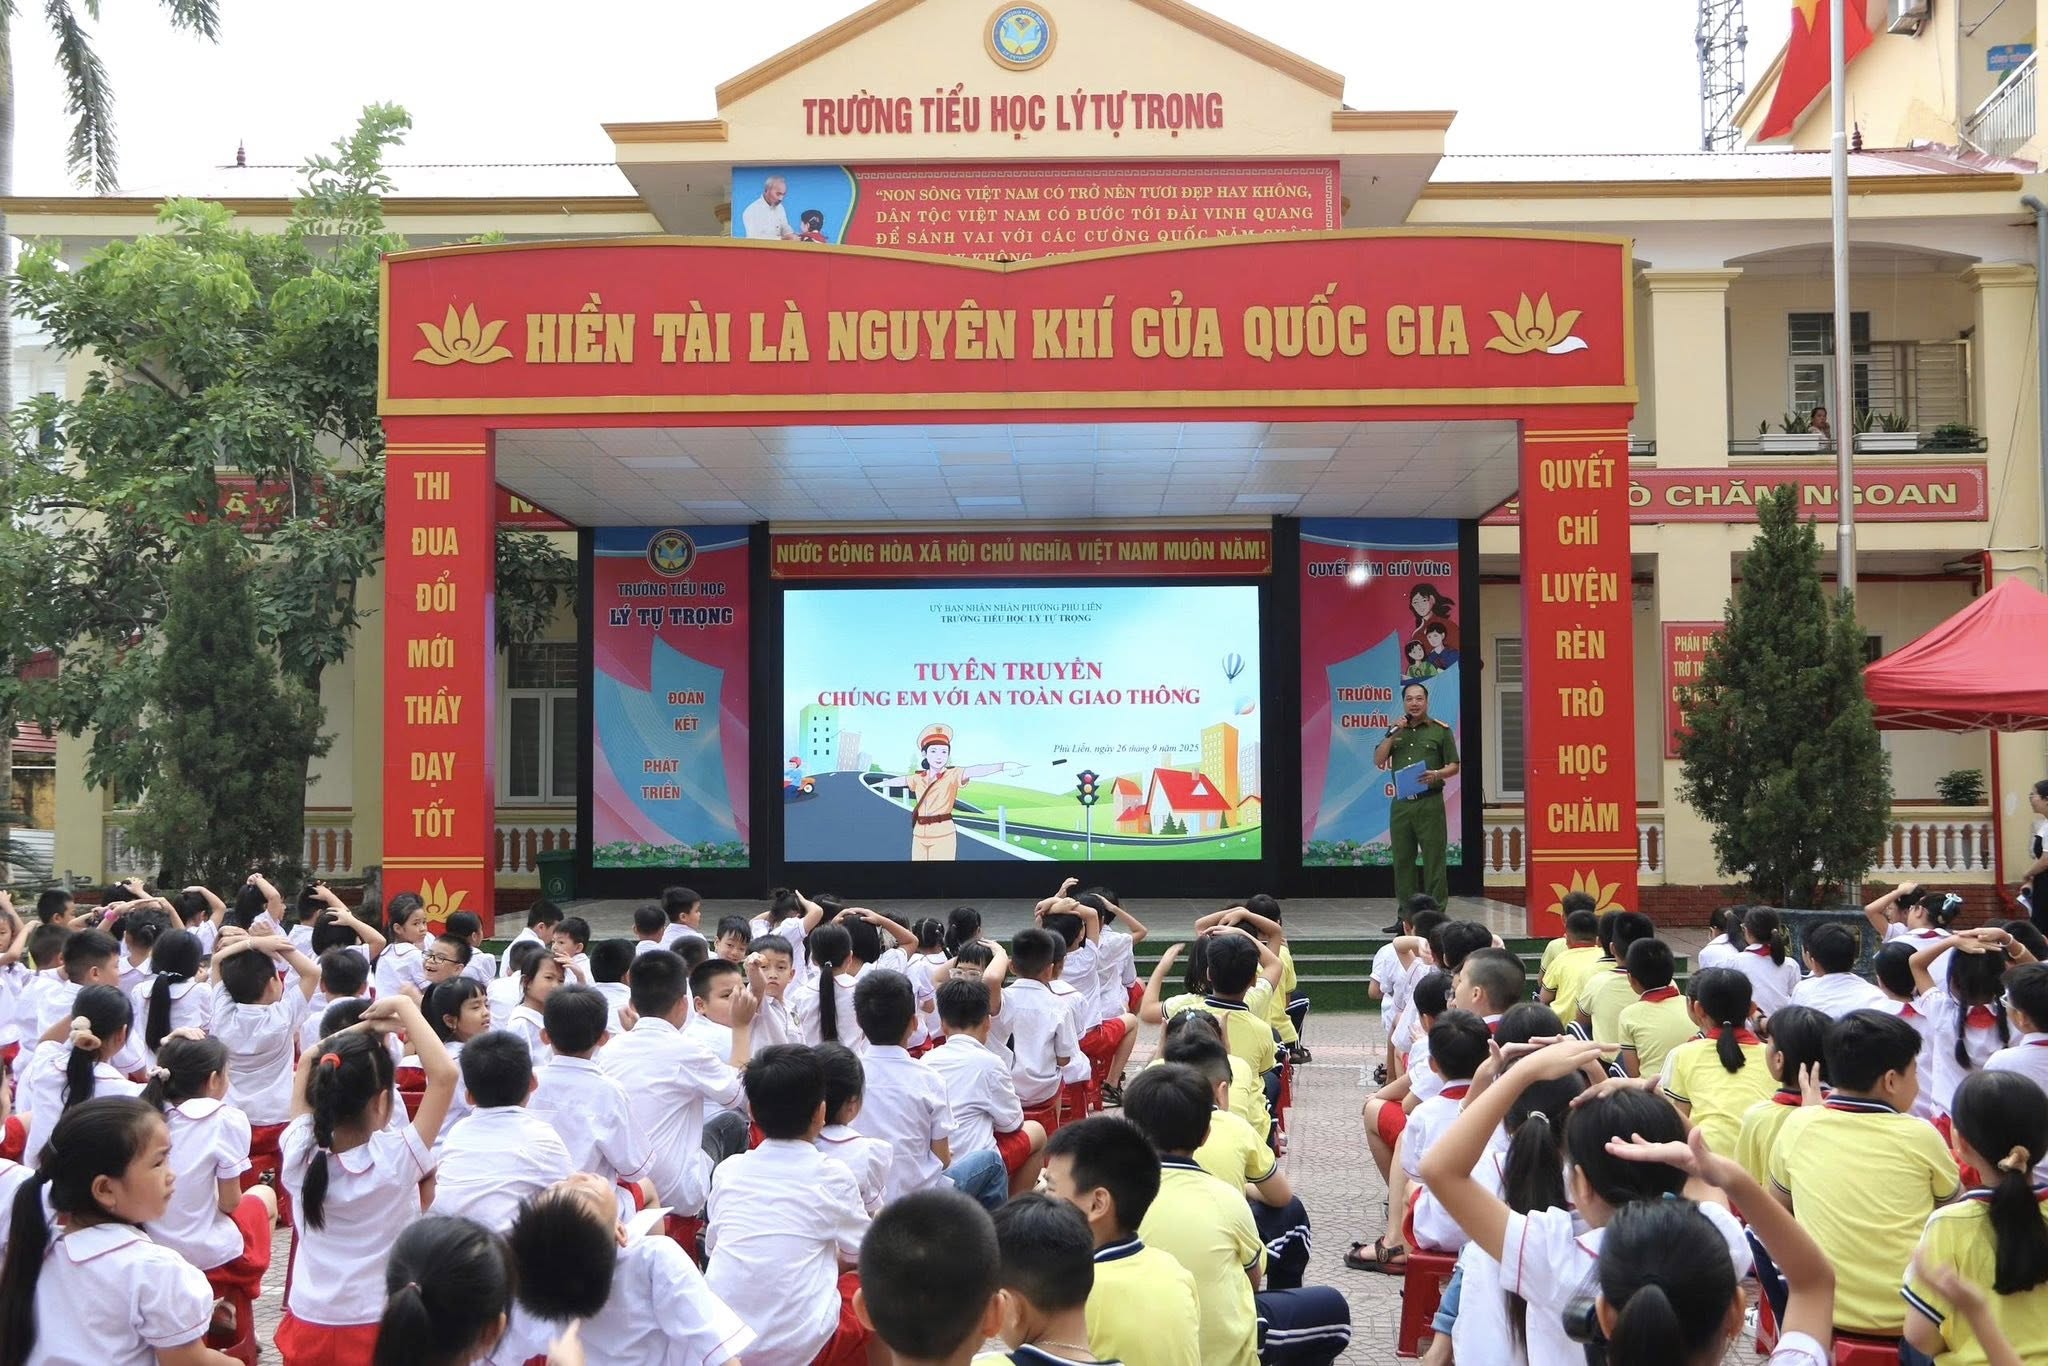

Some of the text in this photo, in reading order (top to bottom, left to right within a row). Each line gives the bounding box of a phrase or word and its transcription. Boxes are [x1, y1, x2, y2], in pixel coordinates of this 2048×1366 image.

[802, 89, 913, 135] TRƯỜNG
[991, 95, 1046, 140] HỌC
[1056, 88, 1087, 131] LÝ
[1090, 90, 1128, 138] TỰ
[1131, 92, 1223, 138] TRỌNG
[919, 186, 961, 201] SÔNG
[965, 185, 1001, 203] VIỆT
[1005, 188, 1039, 200] NAM
[1043, 184, 1064, 200] CÓ
[1068, 183, 1099, 199] TRỞ
[1103, 184, 1136, 199] NÊN
[1140, 185, 1178, 199] TƯƠI
[1181, 186, 1213, 201] ĐẸP
[1217, 186, 1248, 198] HAY
[1252, 183, 1312, 200] KHÔNG,
[876, 205, 1313, 225] DÂN TỘC VIỆT NAM CÓ BƯỚC TỚI ĐÀI VINH QUANG
[876, 226, 900, 244] ĐỂ
[907, 229, 955, 244] SÁNH
[962, 231, 994, 243] VAI
[1001, 229, 1033, 243] VỚI
[1041, 229, 1076, 243] CÁC
[1157, 225, 1208, 241] QUỐC
[526, 282, 1470, 363] HIỀN TÀI LÀ NGUYÊN KHÍ CỦA QUỐC GIA
[1540, 449, 1615, 492] QUYẾT
[413, 472, 450, 500] THI
[1558, 509, 1599, 545] CHÍ
[412, 527, 459, 556] ĐUA
[776, 537, 1266, 567] NƯỚC CỘNG HÒA XÃ HỘI CHỦ NGHĨA VIỆT NAM MUÔN NĂM!
[1308, 558, 1452, 578] QUYẾT ÂM GIỮ VỮNG
[416, 569, 456, 612] ĐỔI
[618, 578, 725, 598] TRƯỜNG TIỂU HỌC
[1541, 566, 1618, 609] LUYỆN
[609, 604, 733, 631] LÝ TỰ TRỌNG
[940, 613, 981, 623] TRƯỜNG
[1006, 614, 1027, 624] HỌC
[1059, 614, 1092, 624] TRỌNG
[945, 604, 965, 612] BAN
[408, 632, 454, 668] MỚI
[1556, 623, 1605, 660] RÈN
[914, 656, 1103, 680] TUYÊN TRUYỀN
[404, 686, 462, 724] THẦY
[667, 688, 705, 705] ĐOÀN
[817, 684, 1200, 706] CHÚNG EM VỚI AN TOÀN GIAO THÔNG
[1336, 684, 1392, 701] TRƯỜNG
[1558, 680, 1605, 717] TRÒ
[674, 714, 699, 731] KẾT
[1116, 744, 1127, 753] 26
[1152, 743, 1158, 753] 9
[1179, 743, 1199, 752] 2025
[411, 752, 456, 788] DẠY
[643, 757, 679, 773] PHÁT
[1558, 744, 1607, 781] HỌC
[641, 780, 681, 800] TRIỂN
[412, 798, 455, 838] TỐT
[1548, 796, 1619, 833] CHĂM
